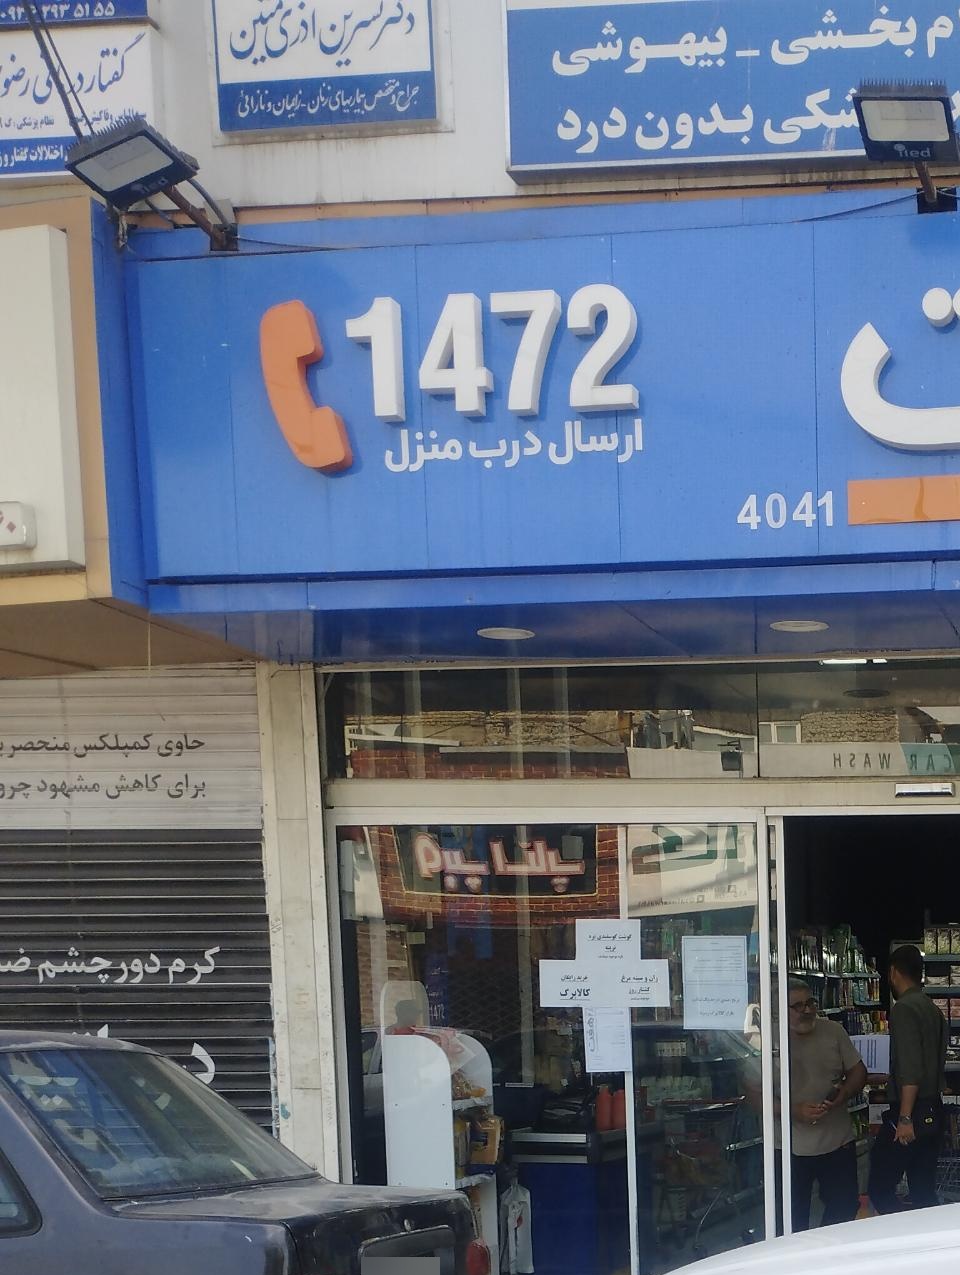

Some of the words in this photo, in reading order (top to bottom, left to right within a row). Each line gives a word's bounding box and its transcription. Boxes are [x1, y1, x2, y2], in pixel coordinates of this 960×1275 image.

[553, 21, 728, 76] بیهوشی
[771, 5, 917, 65] بخشی
[0, 54, 29, 98] رضو
[556, 106, 628, 154] درد
[635, 102, 754, 150] بدون
[346, 284, 640, 422] 1472
[384, 429, 462, 472] منزل
[469, 430, 541, 468] درب
[548, 418, 643, 464] ارسال
[737, 490, 833, 530] 4041
[7, 736, 70, 758] منحصر
[74, 733, 153, 759] کمپلکس
[157, 733, 205, 757] حاوی
[37, 774, 100, 800] مشهود
[105, 773, 162, 800] کاهش
[167, 773, 206, 799] برای
[37, 946, 112, 984] چشم
[113, 952, 161, 983] دور
[168, 945, 220, 984] کرم
